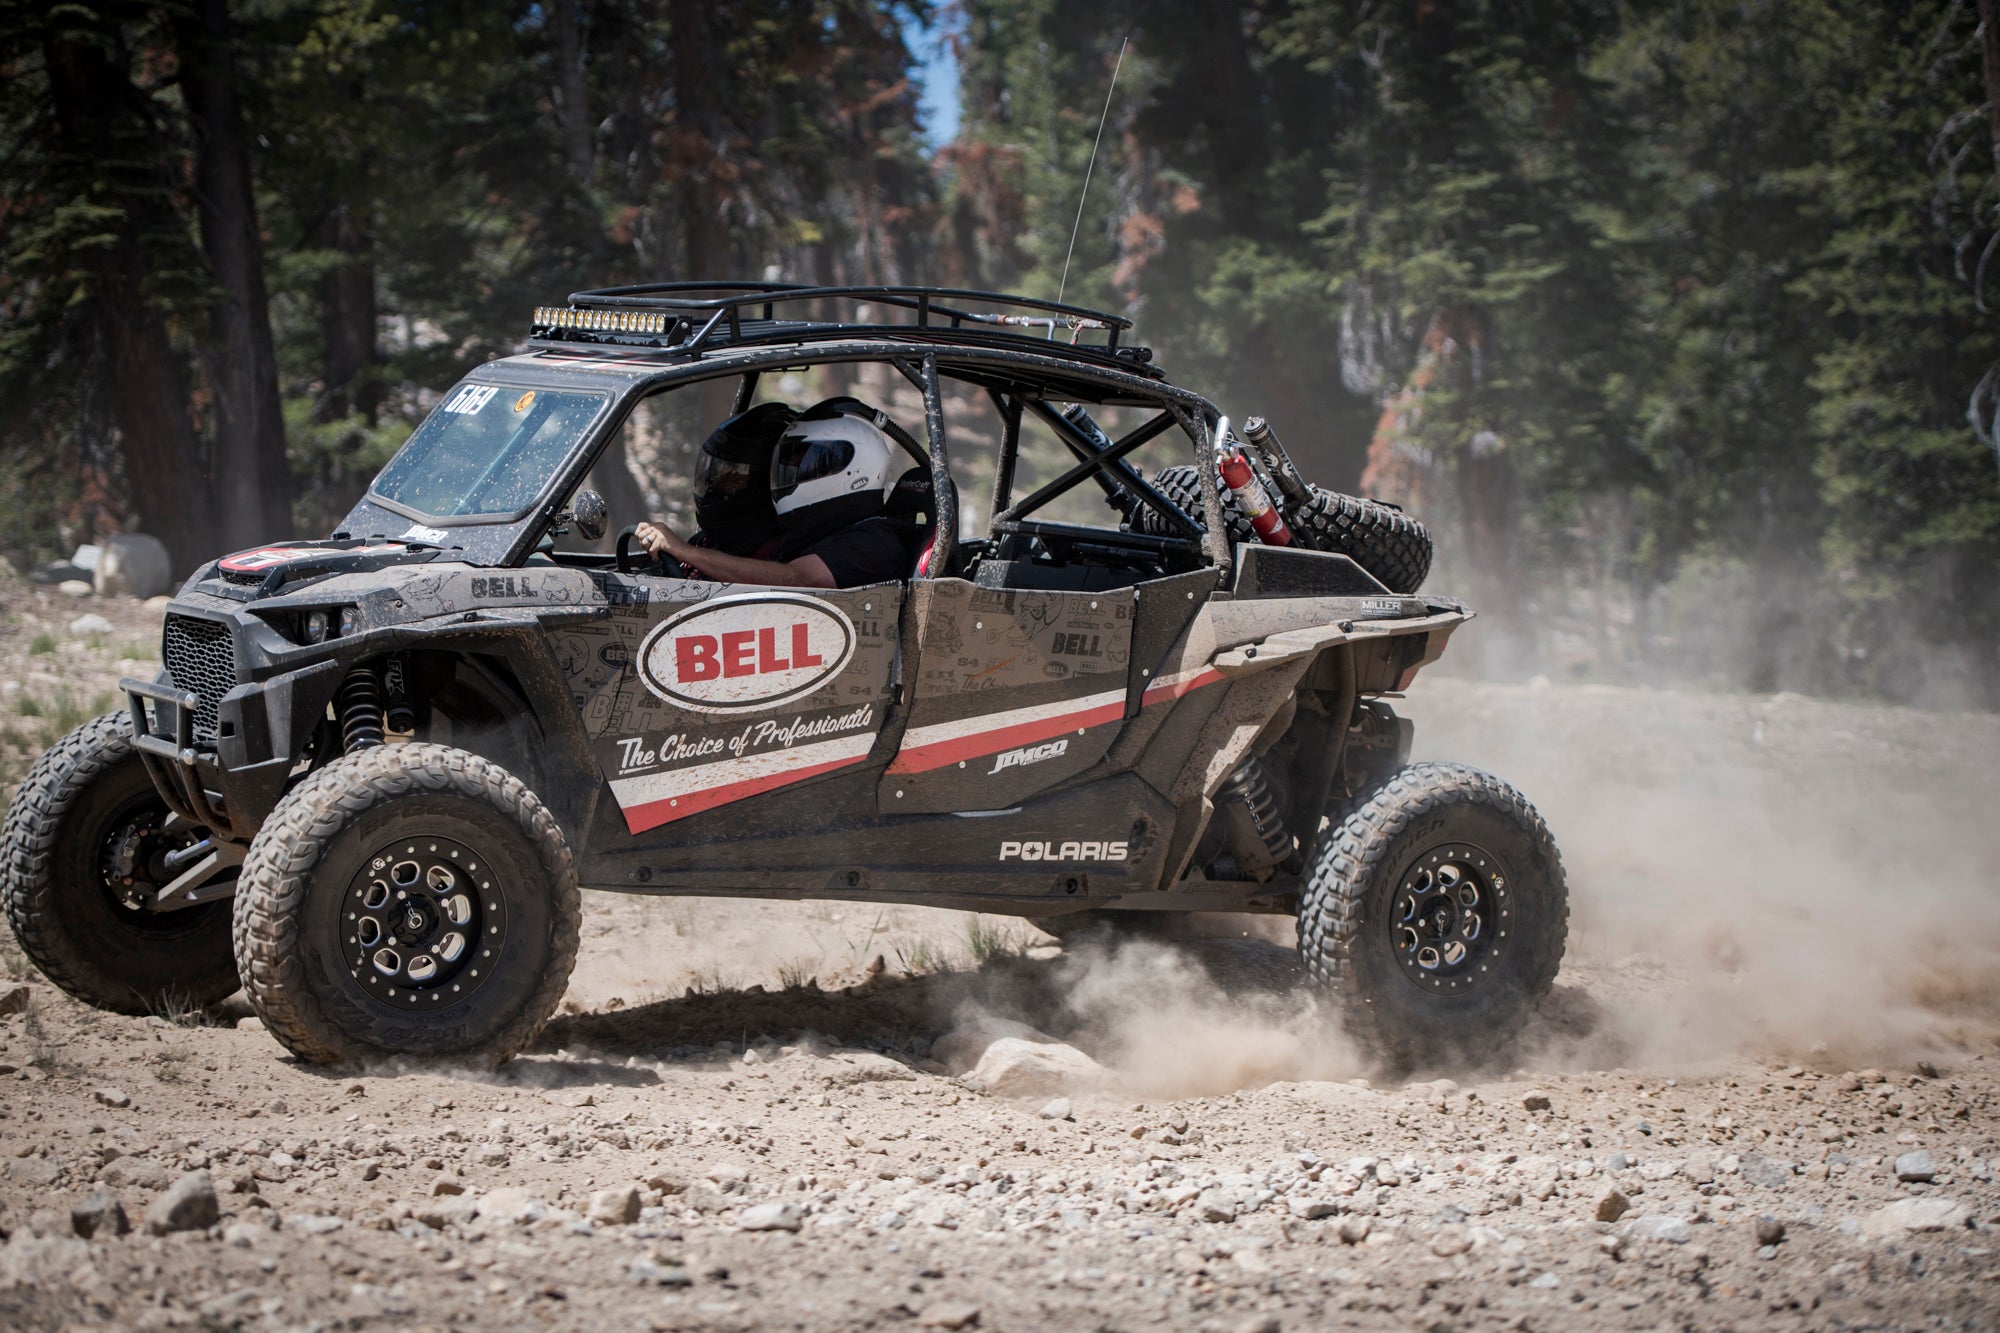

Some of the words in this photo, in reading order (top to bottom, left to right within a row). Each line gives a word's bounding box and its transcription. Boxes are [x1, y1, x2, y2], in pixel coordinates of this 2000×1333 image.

[471, 576, 538, 599] BELL
[1362, 600, 1400, 610] MILLER
[676, 622, 823, 684] BELL
[1051, 632, 1103, 657] BELL
[617, 737, 656, 774] The
[660, 733, 724, 762] Choice
[728, 726, 753, 757] of
[754, 703, 874, 748] Professionals
[999, 841, 1129, 862] POLARIS
